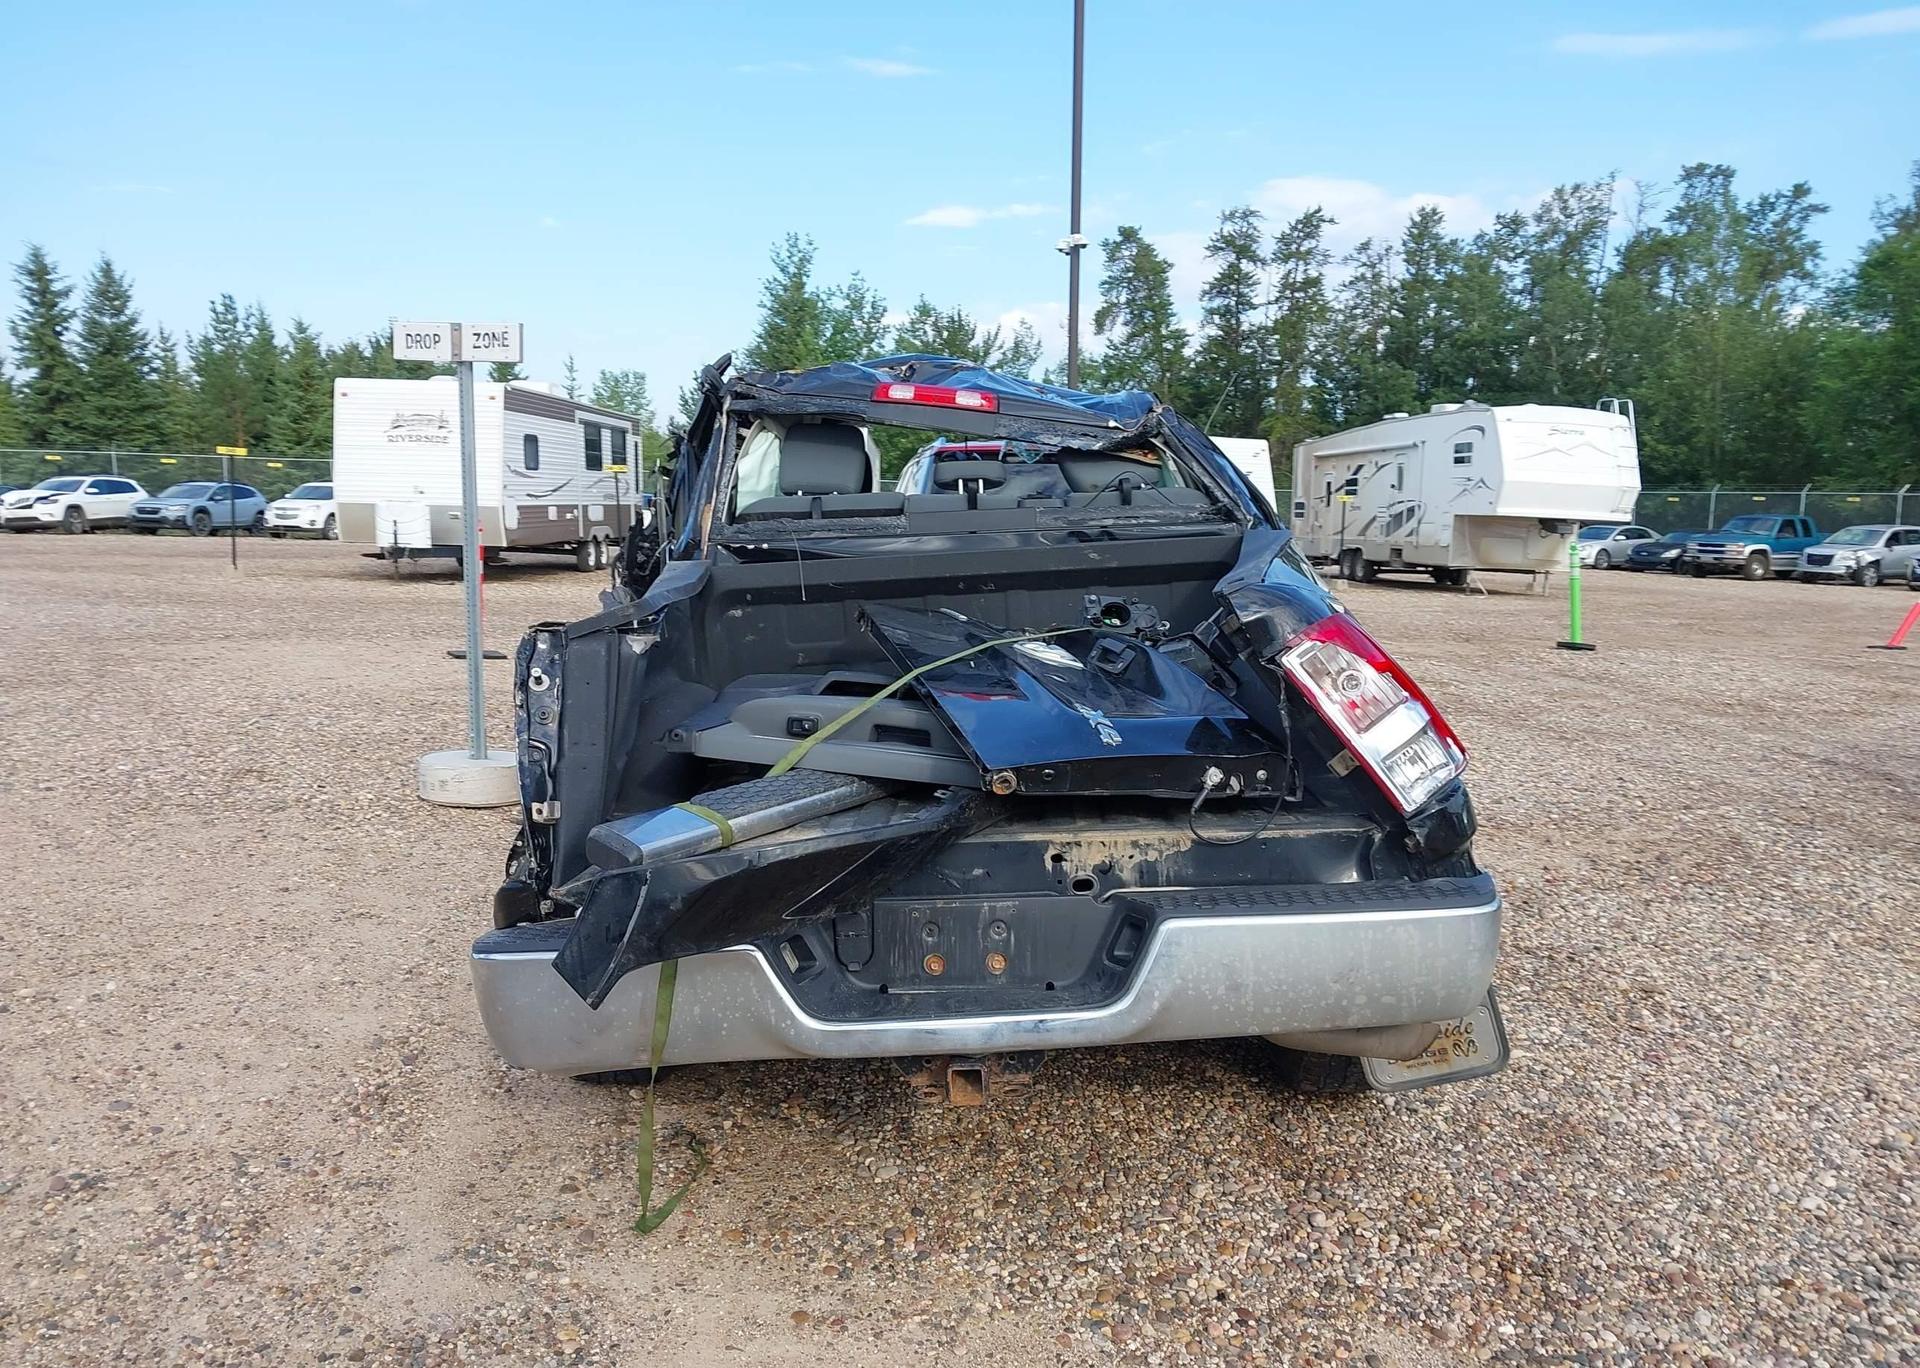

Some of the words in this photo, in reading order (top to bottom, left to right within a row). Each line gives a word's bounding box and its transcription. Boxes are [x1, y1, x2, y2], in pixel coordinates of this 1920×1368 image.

[405, 333, 441, 350] DROP
[472, 331, 510, 349] ZONE
[386, 434, 449, 445] RIVERSIDE
